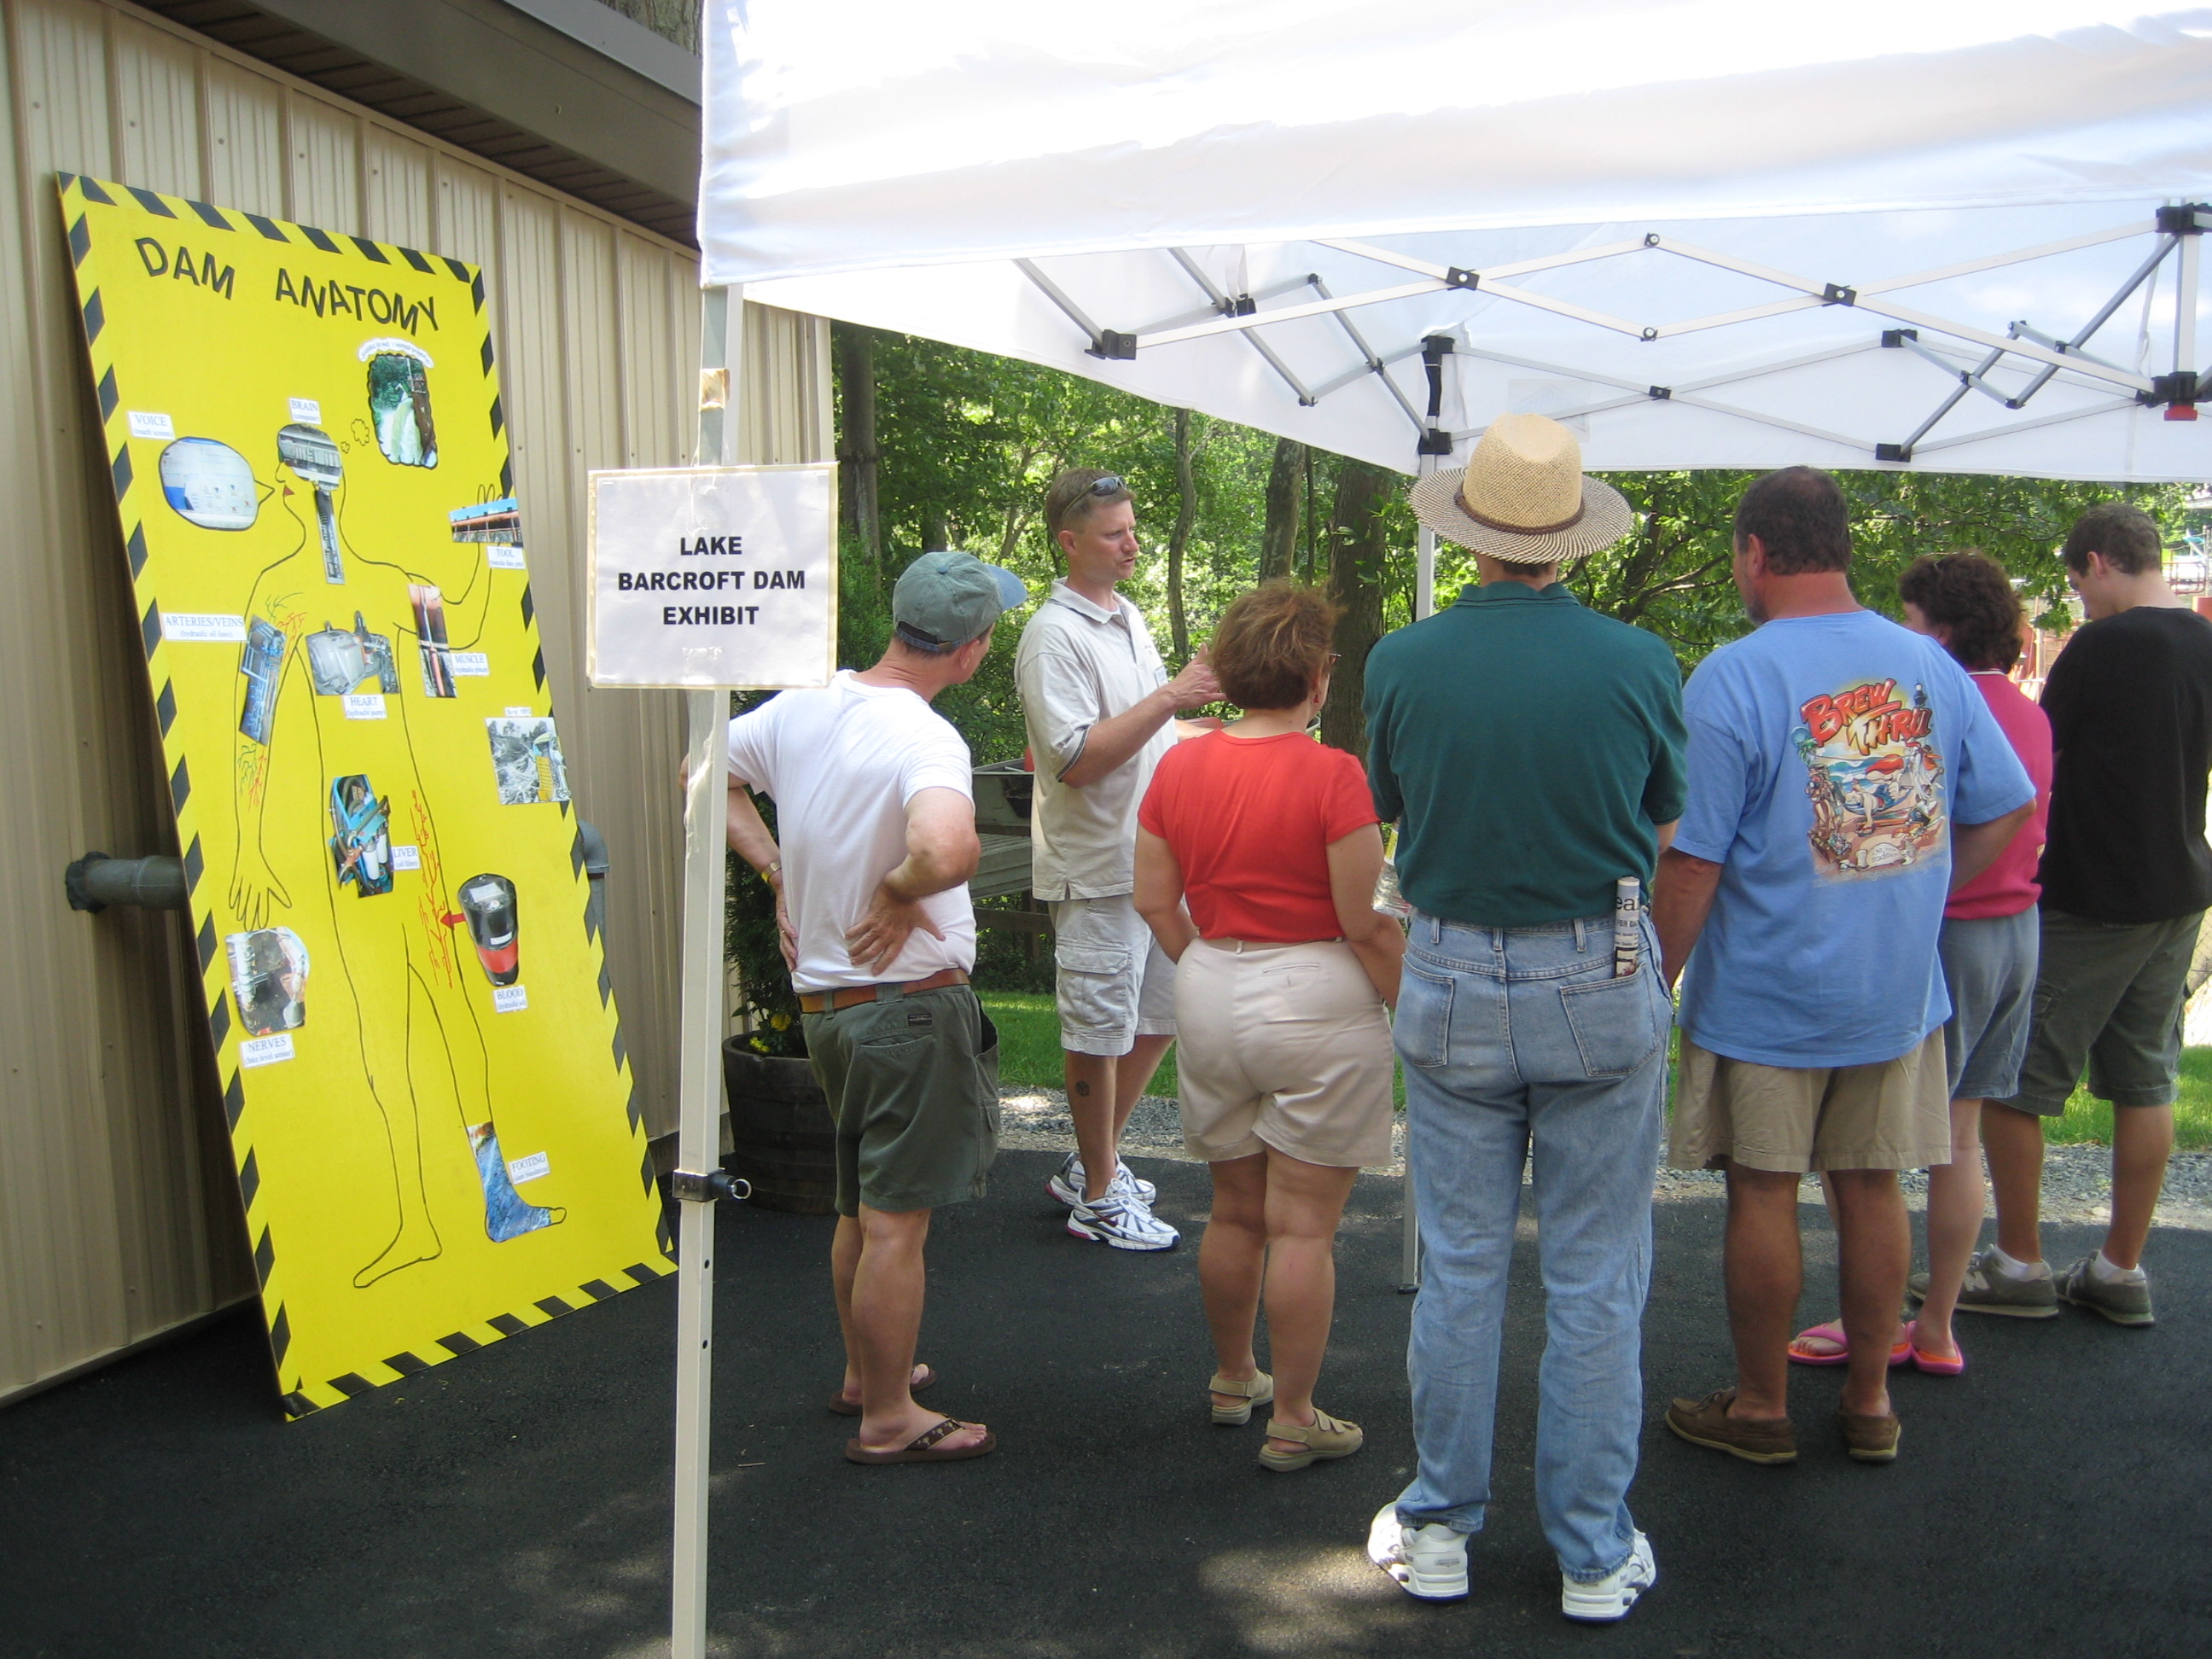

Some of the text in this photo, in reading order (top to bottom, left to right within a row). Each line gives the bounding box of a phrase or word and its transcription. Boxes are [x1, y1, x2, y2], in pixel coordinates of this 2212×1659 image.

[135, 237, 439, 337] DAM ANATOMY
[291, 399, 318, 411] BRAIN
[134, 414, 167, 427] VOICE
[496, 548, 515, 558] TOOL
[680, 536, 742, 556] LAKE
[619, 570, 805, 591] BARCROFT DAM
[166, 615, 244, 627] ARTERIES/VEINS
[663, 606, 760, 625] EXHIBIT
[454, 655, 486, 664] MUSCLE
[349, 696, 378, 706] HEART
[1799, 678, 1897, 748] BREW
[1846, 700, 1933, 756] THRU
[393, 847, 418, 858] LIVER
[497, 987, 523, 999] BLOOD
[247, 1036, 287, 1052] NERVES
[512, 1153, 546, 1173] FOOTING
